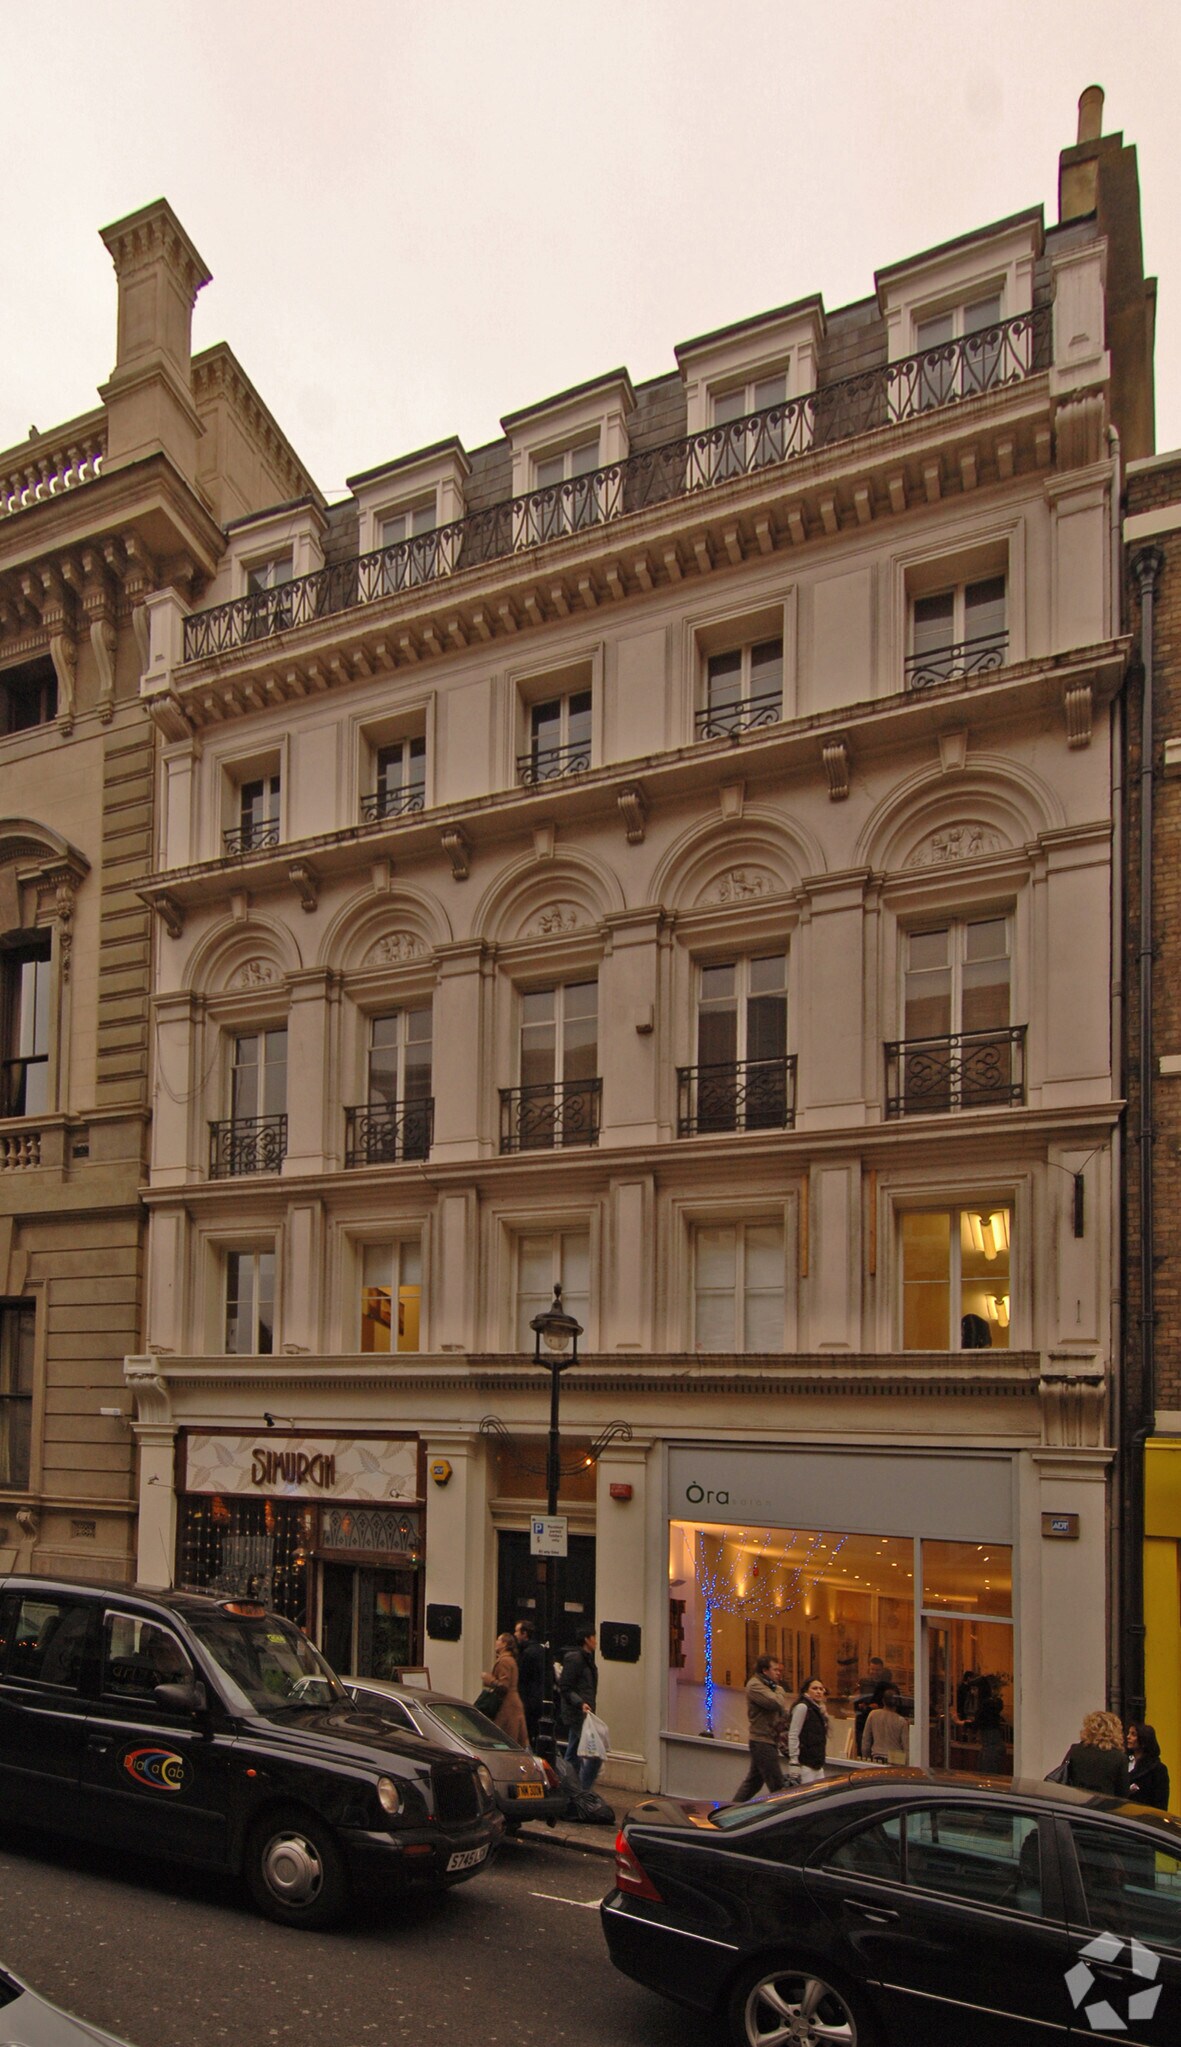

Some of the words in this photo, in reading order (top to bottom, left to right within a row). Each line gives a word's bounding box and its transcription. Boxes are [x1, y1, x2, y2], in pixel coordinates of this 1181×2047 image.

[251, 1448, 336, 1490] SIMURGH
[535, 1522, 543, 1534] P
[1052, 1521, 1069, 1530] ADT
